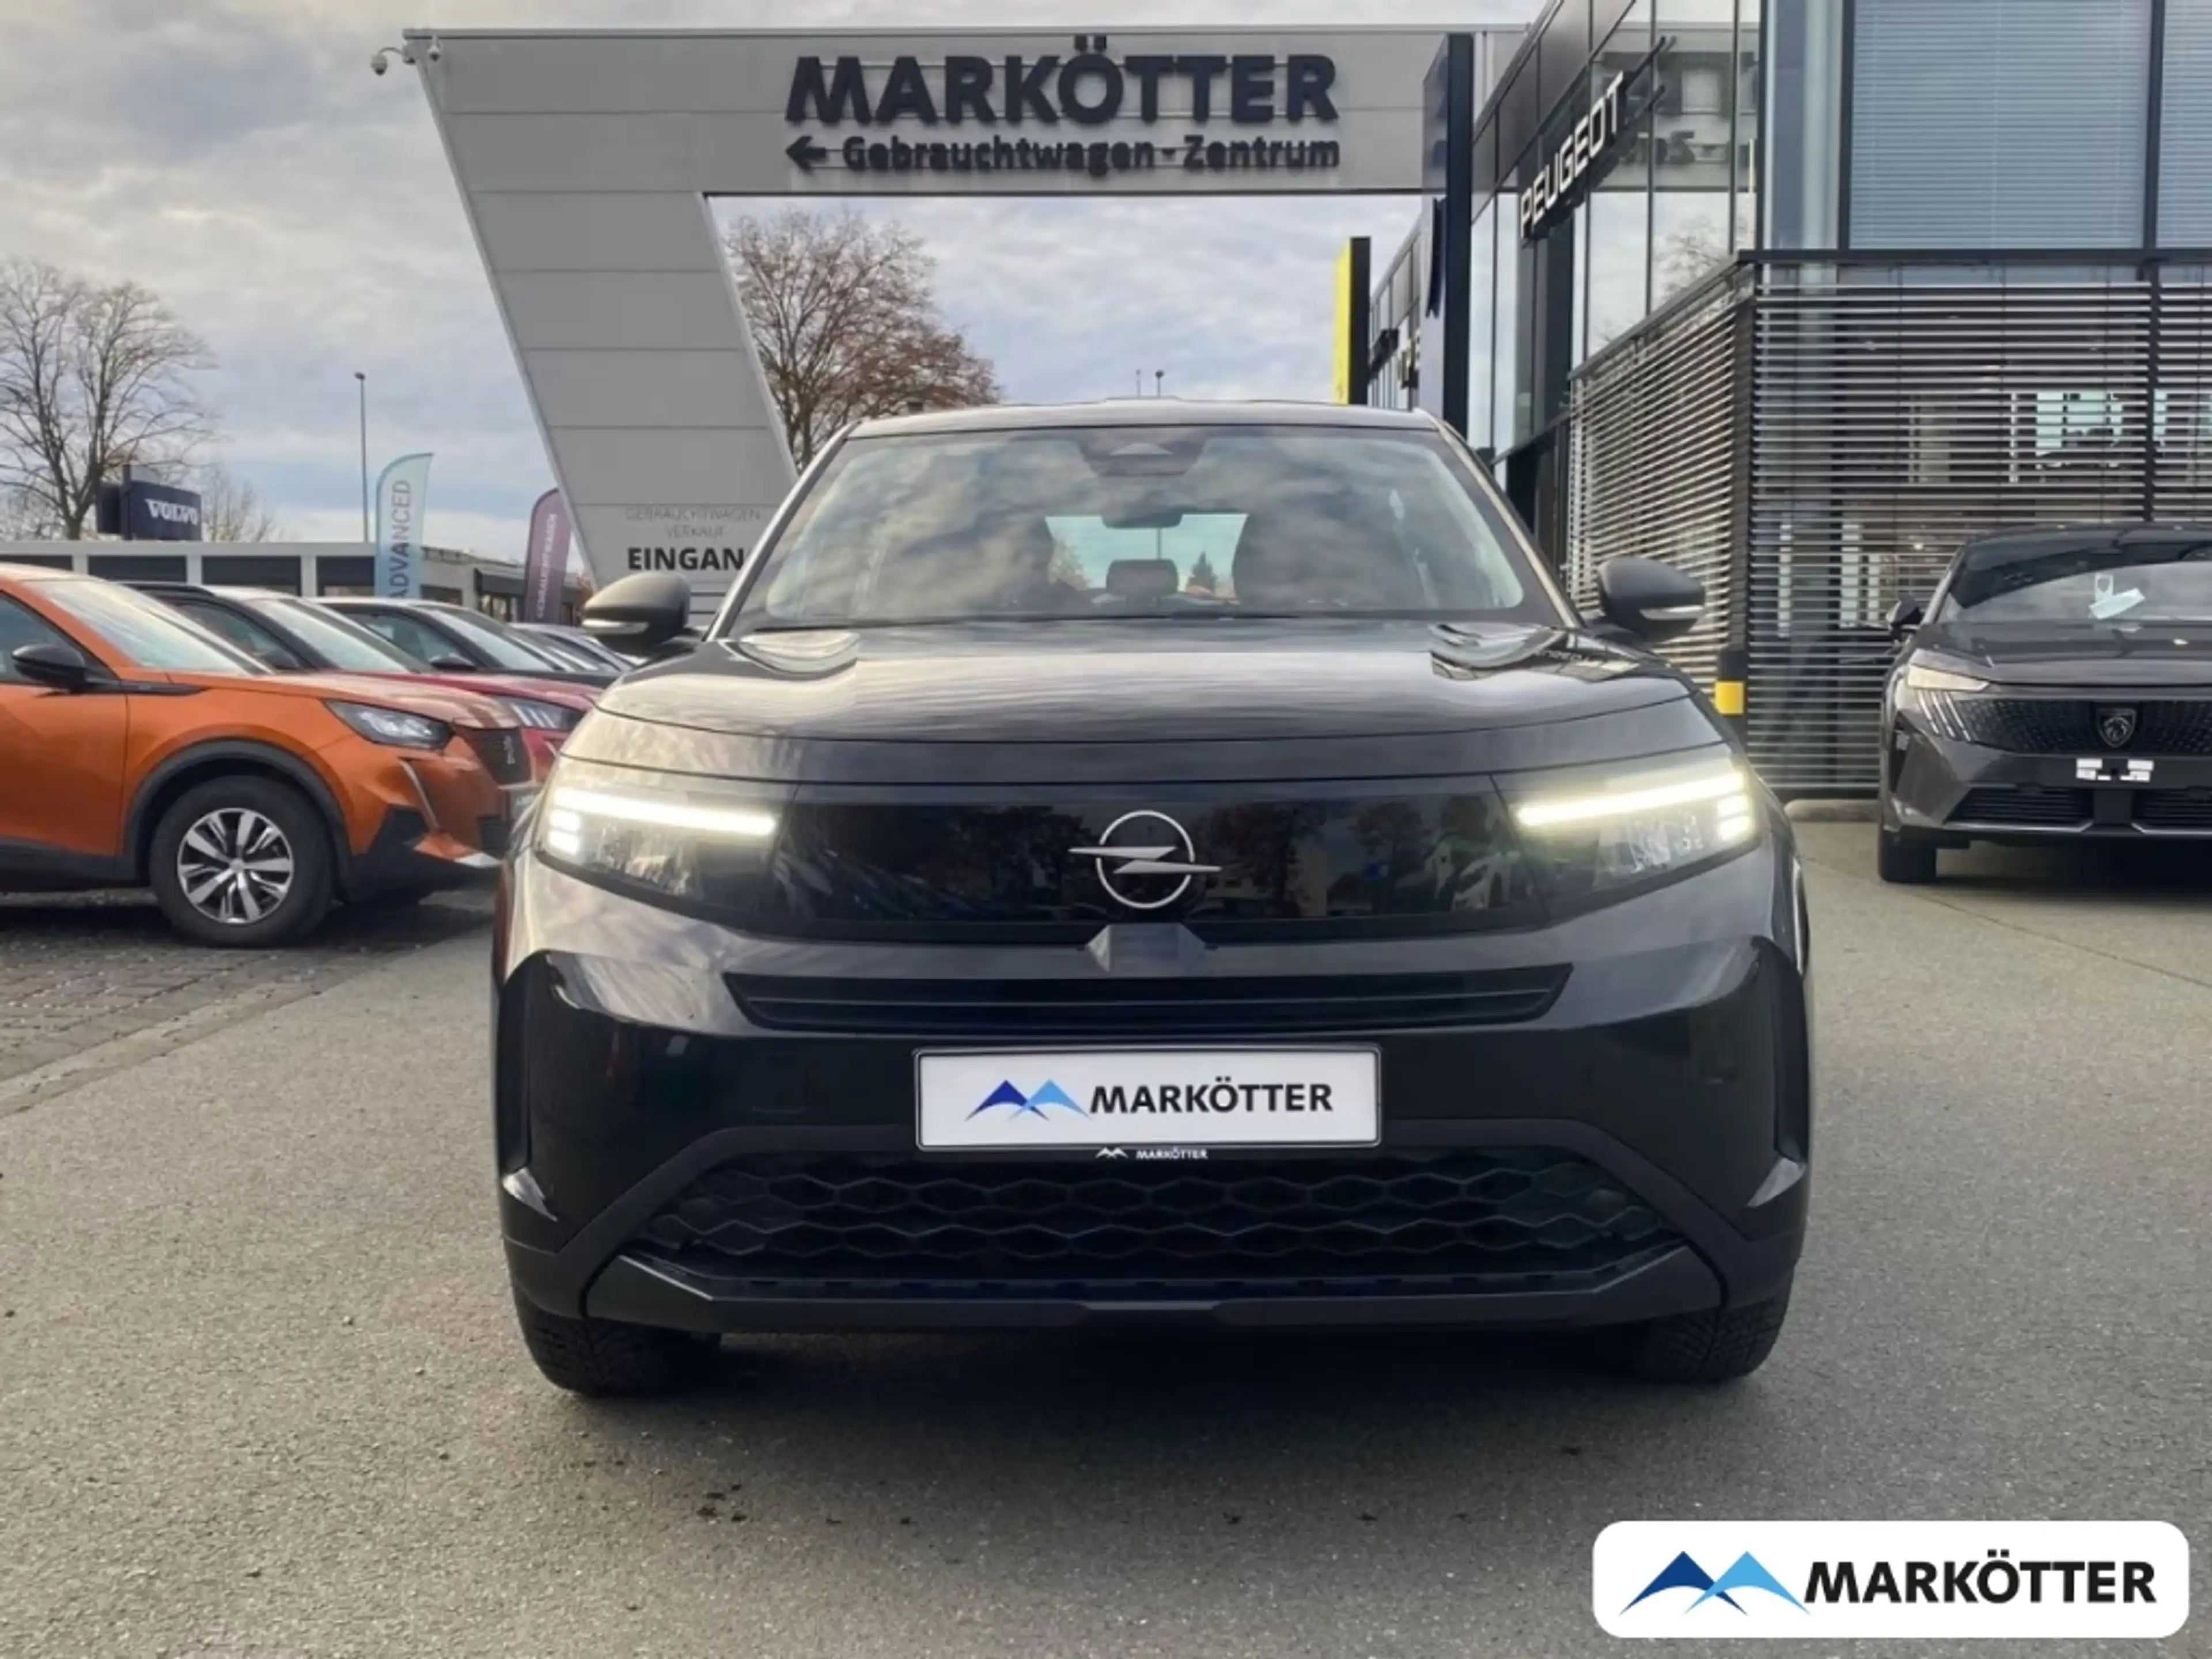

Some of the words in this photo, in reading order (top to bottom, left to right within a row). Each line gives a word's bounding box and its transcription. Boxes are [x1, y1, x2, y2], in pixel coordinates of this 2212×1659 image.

[785, 36, 1340, 124] MARKÖTTER
[1521, 71, 1624, 238] PEUGEOT
[145, 498, 199, 527] VOLVO
[388, 479, 411, 599] ADVANCED
[628, 547, 745, 571] EINGAN
[1090, 1077, 1333, 1114] MARKÖTTER
[1136, 1147, 1209, 1160] MARKÖTTER
